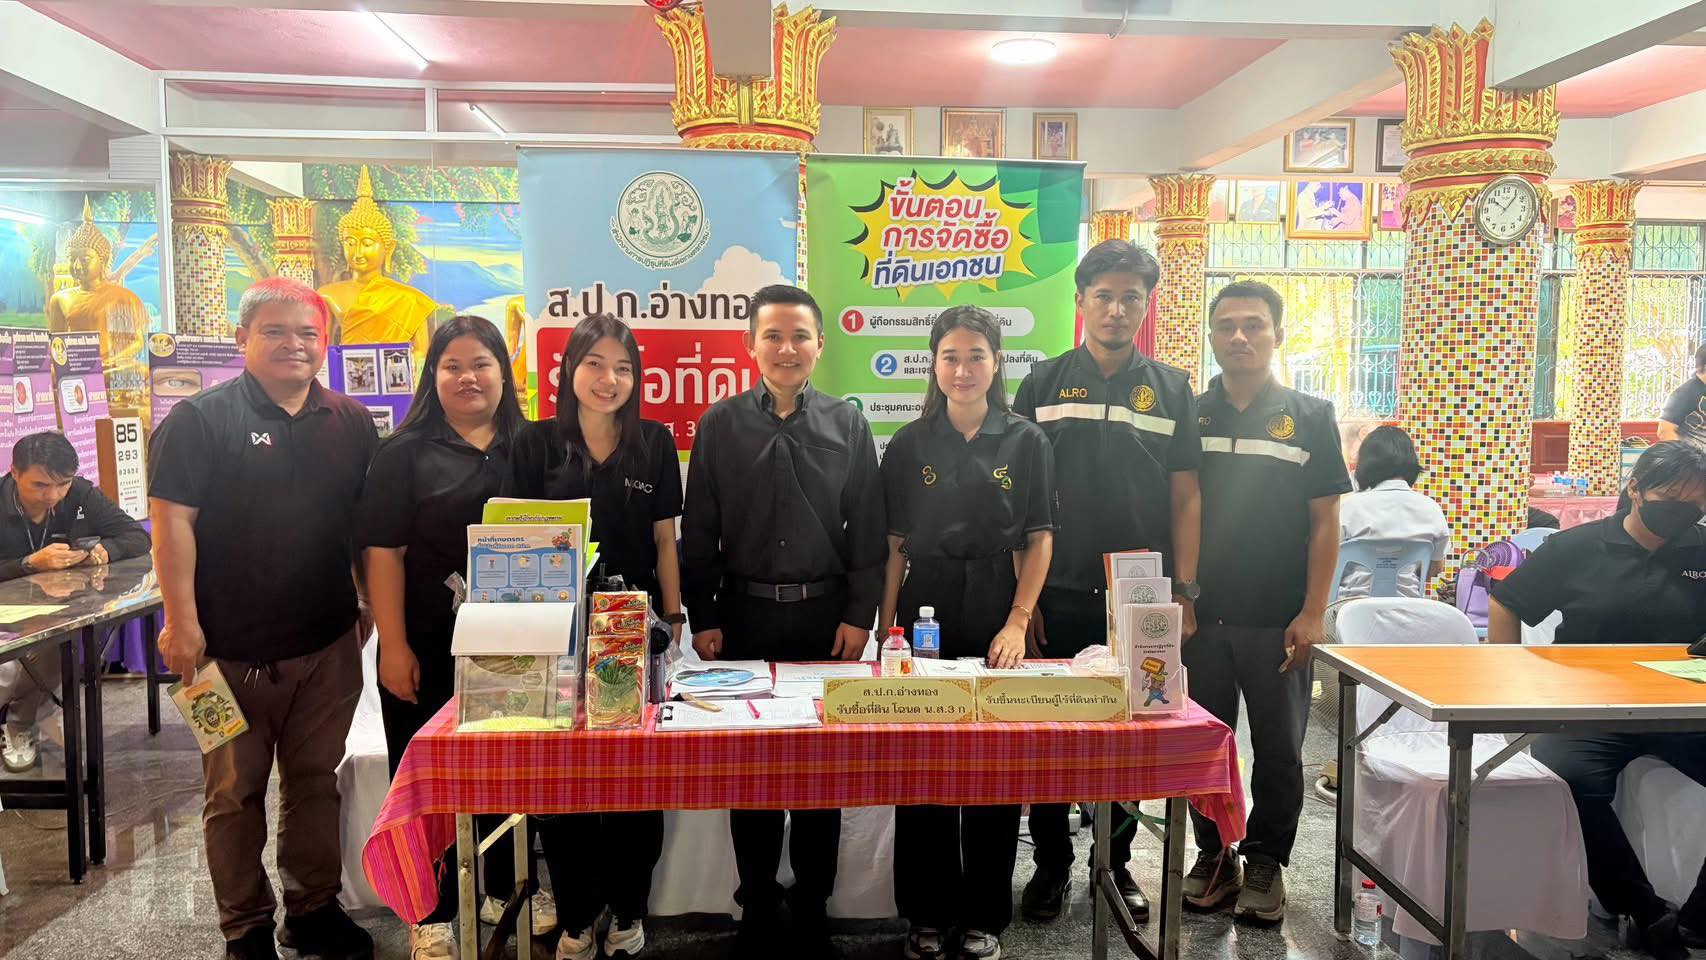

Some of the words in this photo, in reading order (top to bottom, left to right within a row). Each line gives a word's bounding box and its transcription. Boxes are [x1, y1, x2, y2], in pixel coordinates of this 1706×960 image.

[889, 180, 982, 219] ขั้นตอน
[882, 212, 1009, 251] การจัดซื้อ
[873, 251, 1002, 287] ที่ดินเอกชน
[548, 282, 751, 321] ส.ปก.อ่างทอ
[847, 312, 858, 334] 1
[869, 313, 937, 329] ผู้ถือกรรมสิทธิ์
[880, 354, 892, 373] 2
[903, 353, 931, 363] ส.ป.ก.
[904, 366, 932, 375] และเจร
[1059, 386, 1088, 399] ALRO
[116, 424, 138, 443] 85
[863, 686, 939, 697] ส.ป.ก.อ่างทอง
[836, 701, 890, 715] รับซื้อที่ดิน
[891, 702, 921, 714] โฉนด
